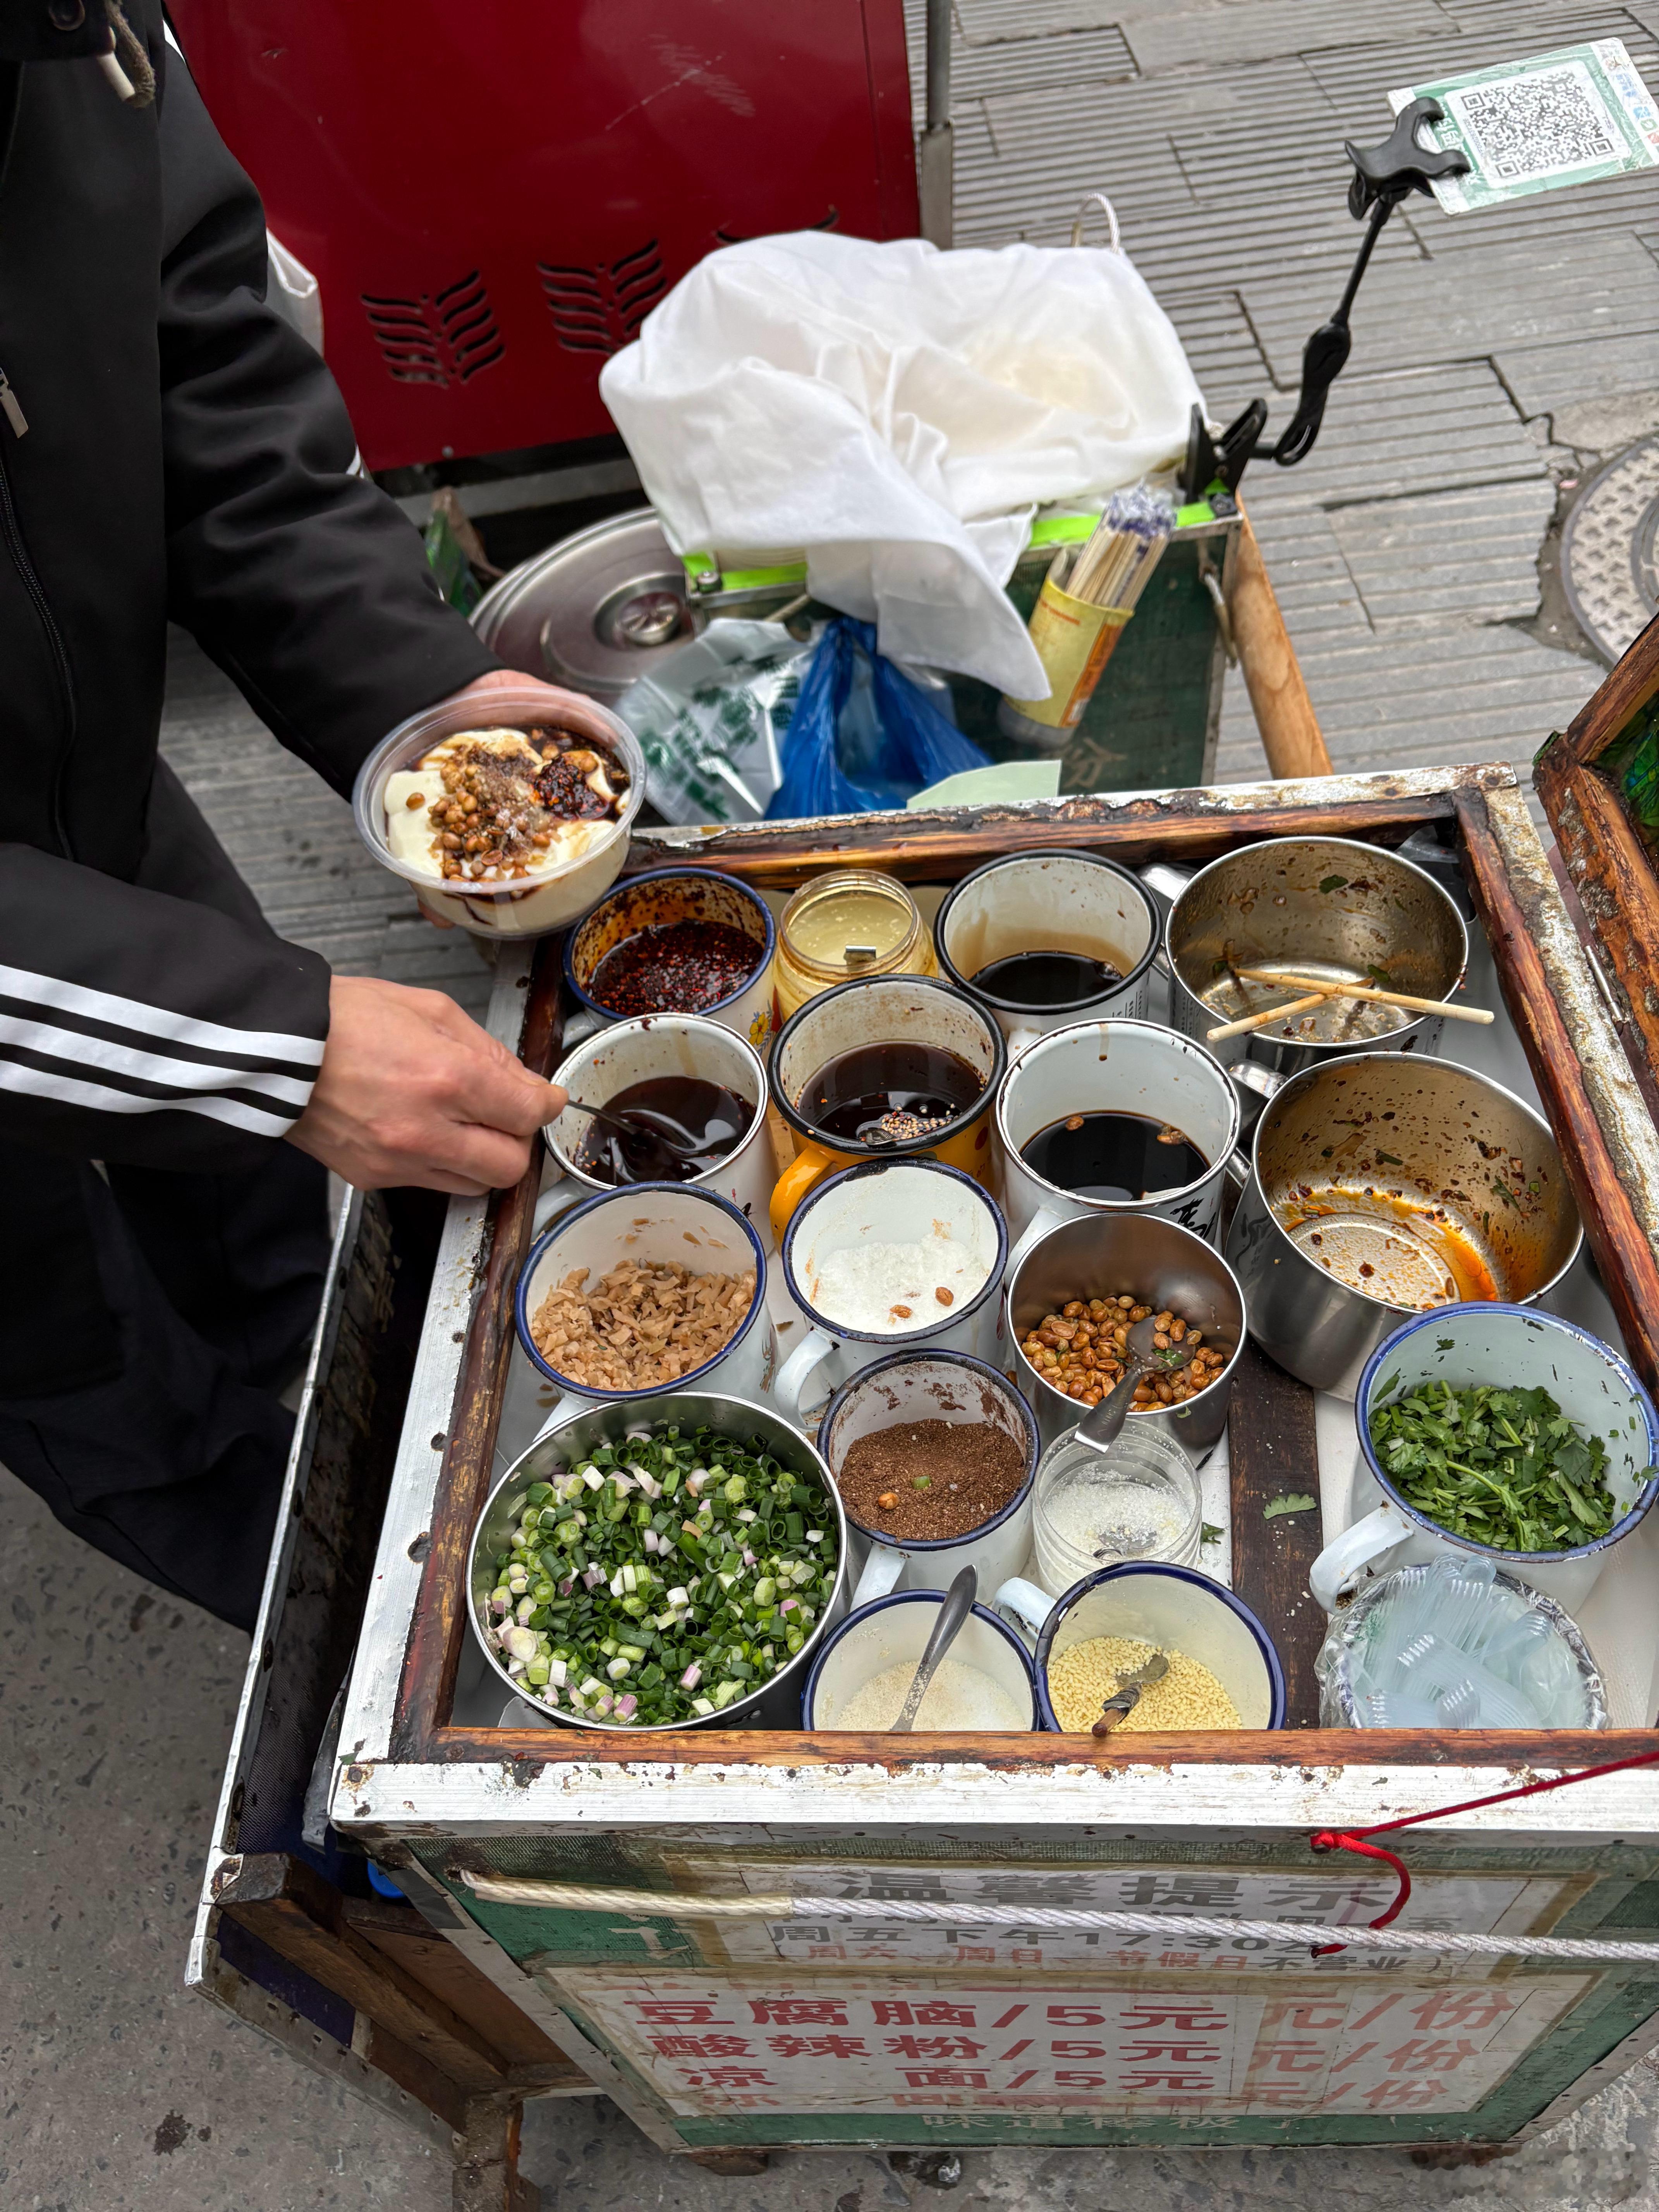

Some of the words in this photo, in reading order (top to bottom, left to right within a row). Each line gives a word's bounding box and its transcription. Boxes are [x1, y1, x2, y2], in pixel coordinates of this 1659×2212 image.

[832, 1872, 1393, 1910] 温馨提示
[623, 1999, 1229, 2030] 豆腐脑/5元
[646, 2034, 1222, 2062] 酸辣粉/5元
